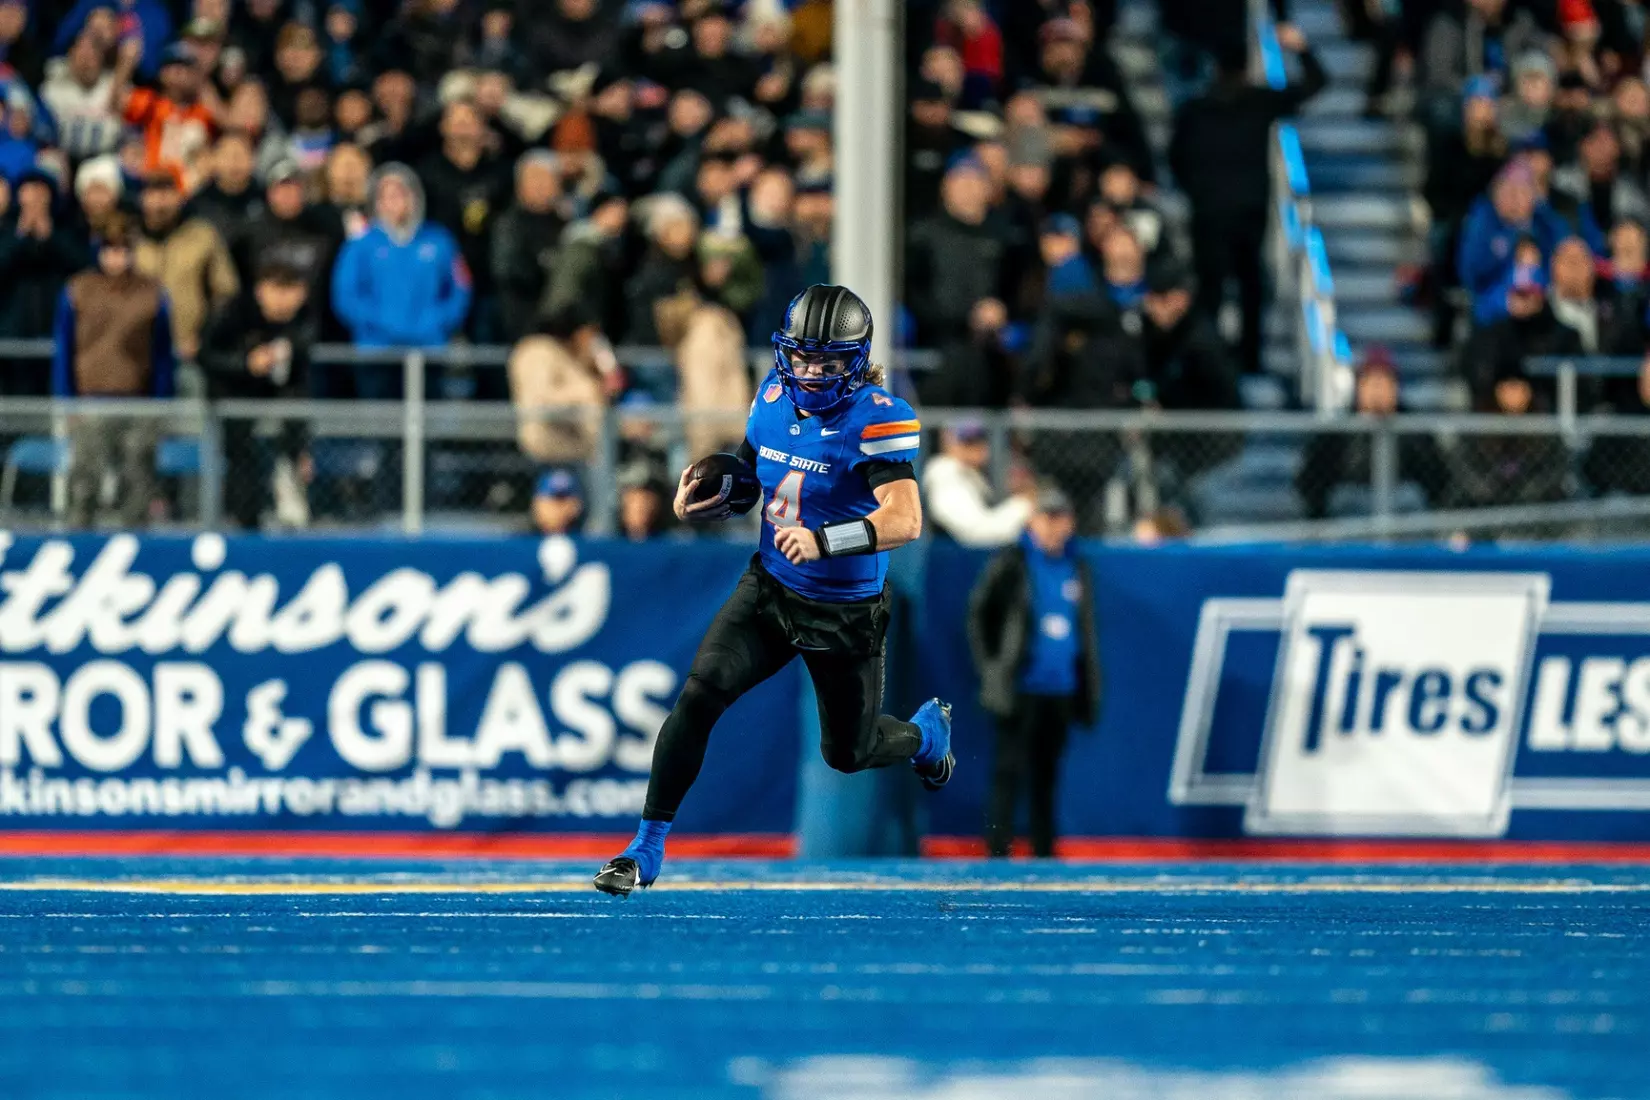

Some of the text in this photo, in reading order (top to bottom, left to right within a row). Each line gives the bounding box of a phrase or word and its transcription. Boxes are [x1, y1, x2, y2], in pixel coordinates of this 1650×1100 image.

[871, 392, 894, 407] 4
[766, 470, 806, 528] 4
[789, 456, 831, 474] STATE
[0, 532, 611, 655] tkinson's
[243, 679, 312, 770] &
[327, 659, 677, 772] GLASS
[1303, 624, 1503, 753] Tires
